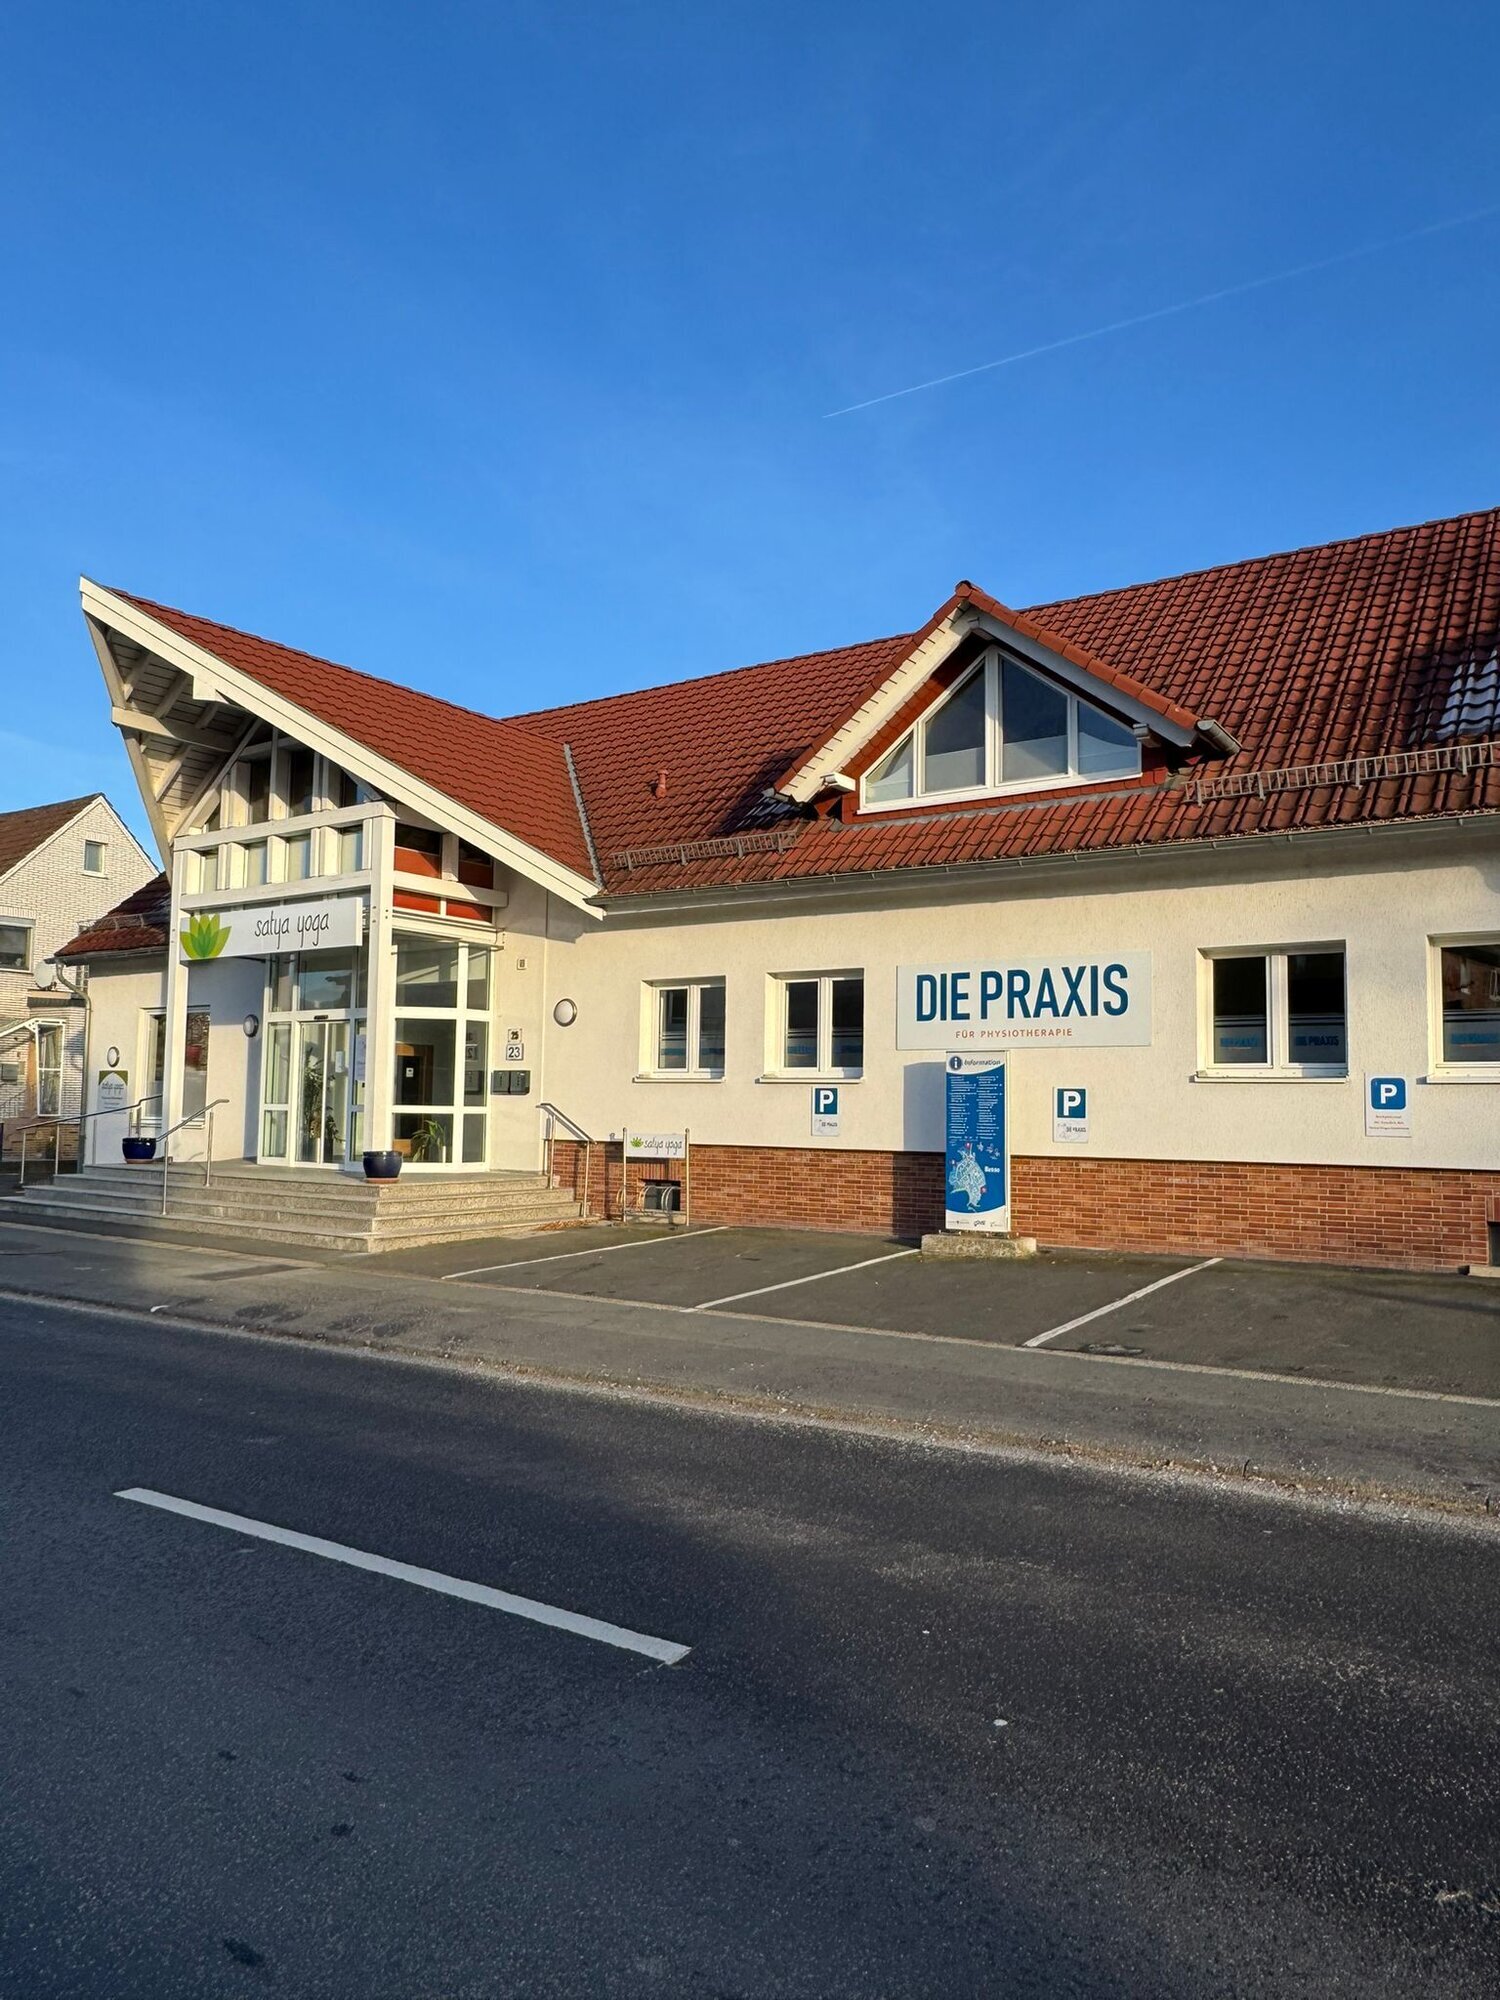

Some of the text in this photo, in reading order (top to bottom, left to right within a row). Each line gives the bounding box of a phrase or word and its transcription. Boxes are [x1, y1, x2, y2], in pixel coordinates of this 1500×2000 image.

[254, 911, 330, 949] satya yoga
[916, 963, 1129, 1021] DIE PRAXIS
[955, 1027, 1073, 1039] FÜR PHYSIOTHERAPIE
[508, 1046, 521, 1058] 23
[819, 1089, 834, 1113] P
[1063, 1090, 1081, 1116] P
[1380, 1083, 1398, 1105] P
[665, 1140, 683, 1155] yoga
